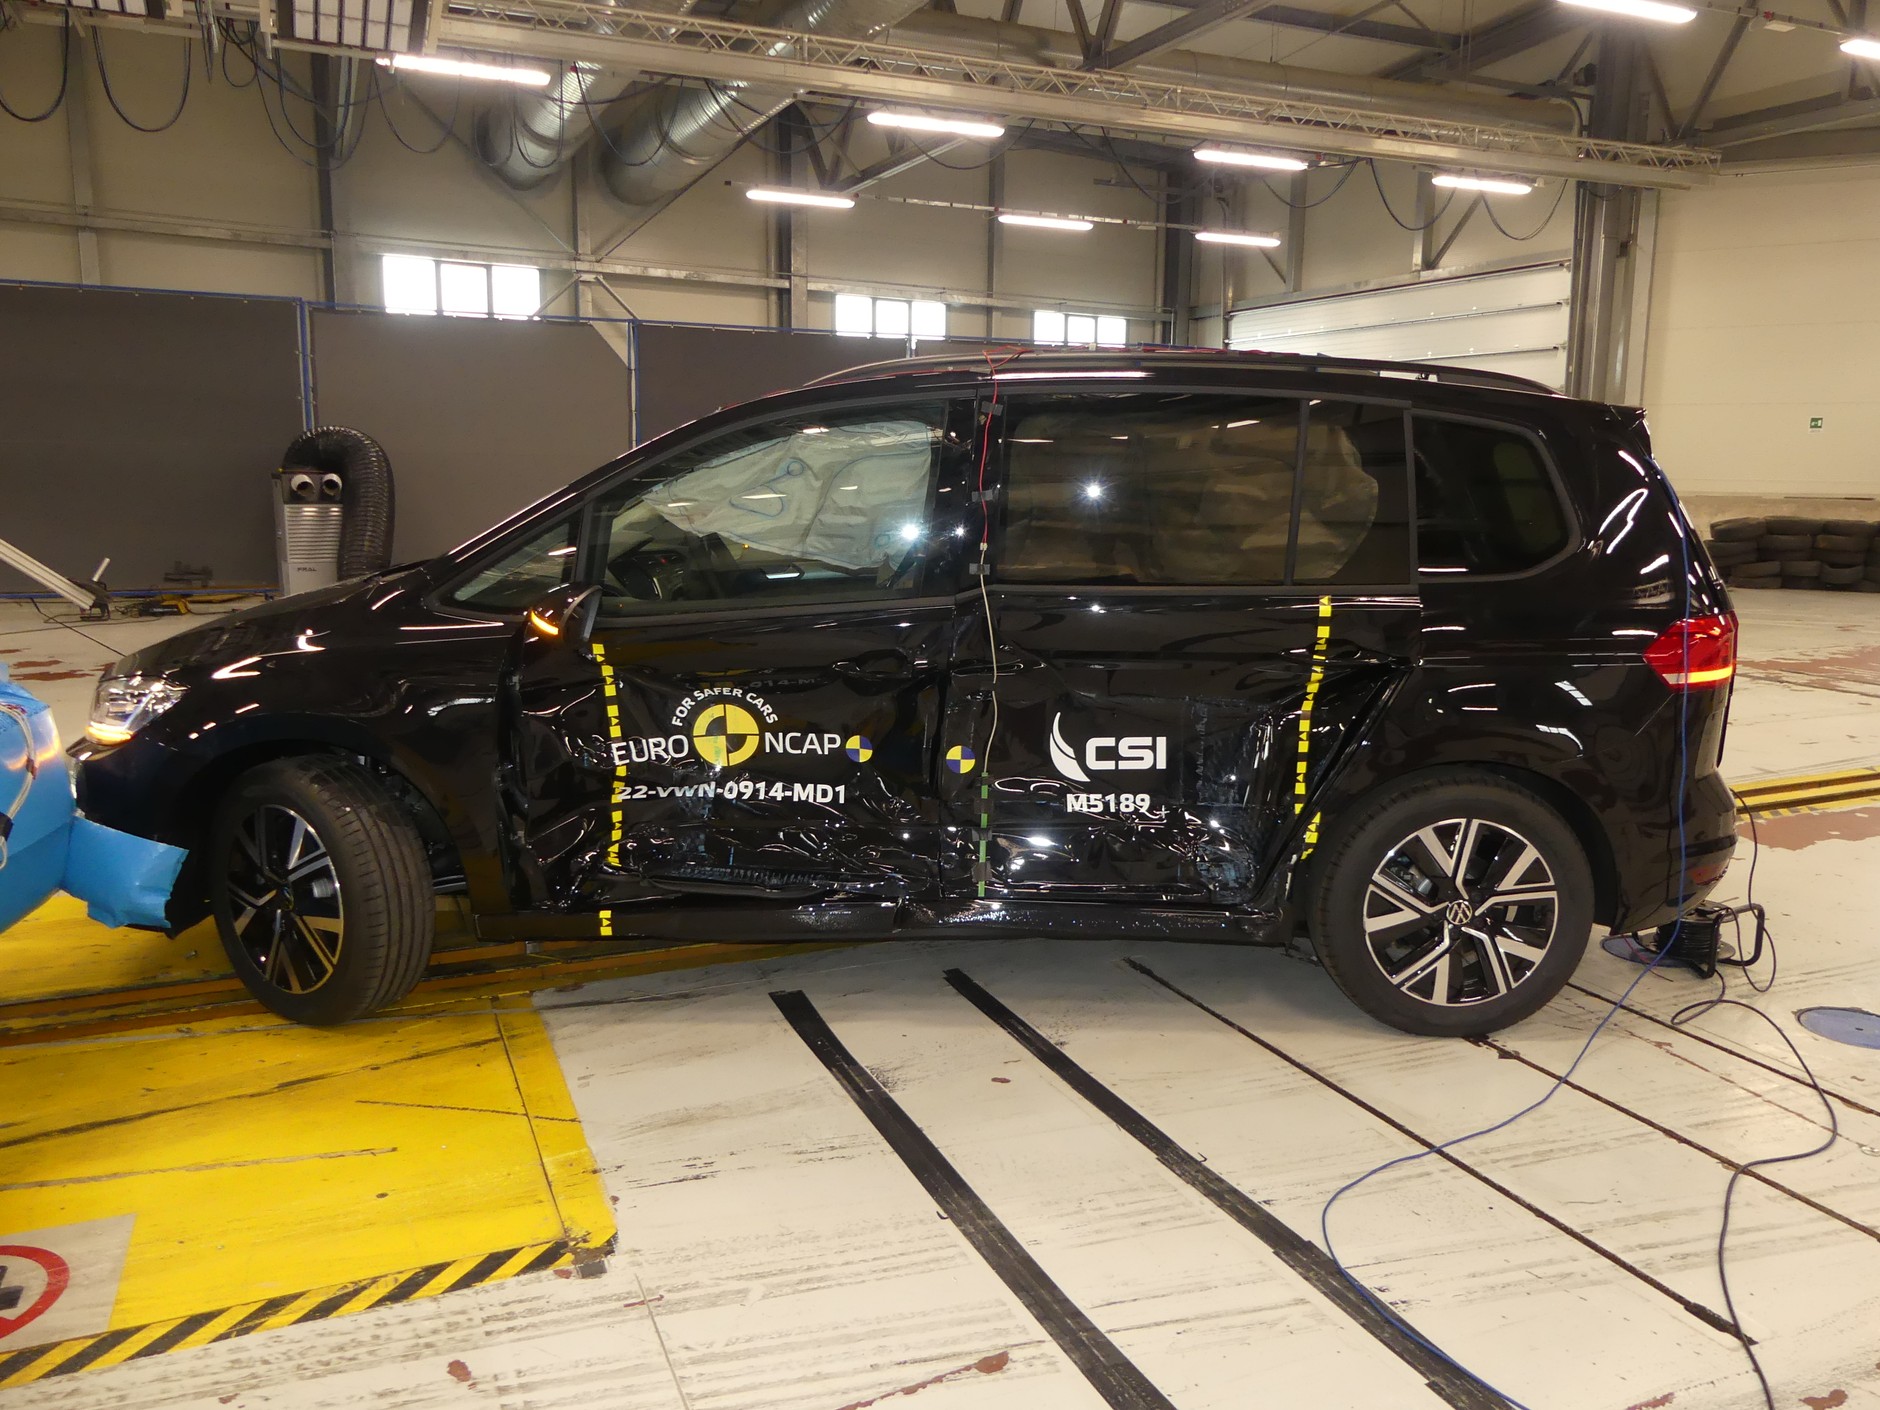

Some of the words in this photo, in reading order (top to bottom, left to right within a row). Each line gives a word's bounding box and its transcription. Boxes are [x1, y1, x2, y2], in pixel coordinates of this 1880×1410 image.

[672, 697, 696, 726] FOR
[694, 687, 743, 701] SAFER
[746, 692, 778, 724] CARS
[611, 734, 689, 766] EURO
[764, 732, 841, 755] NCAP
[1086, 736, 1167, 770] CSI
[1066, 793, 1150, 813] M5189
